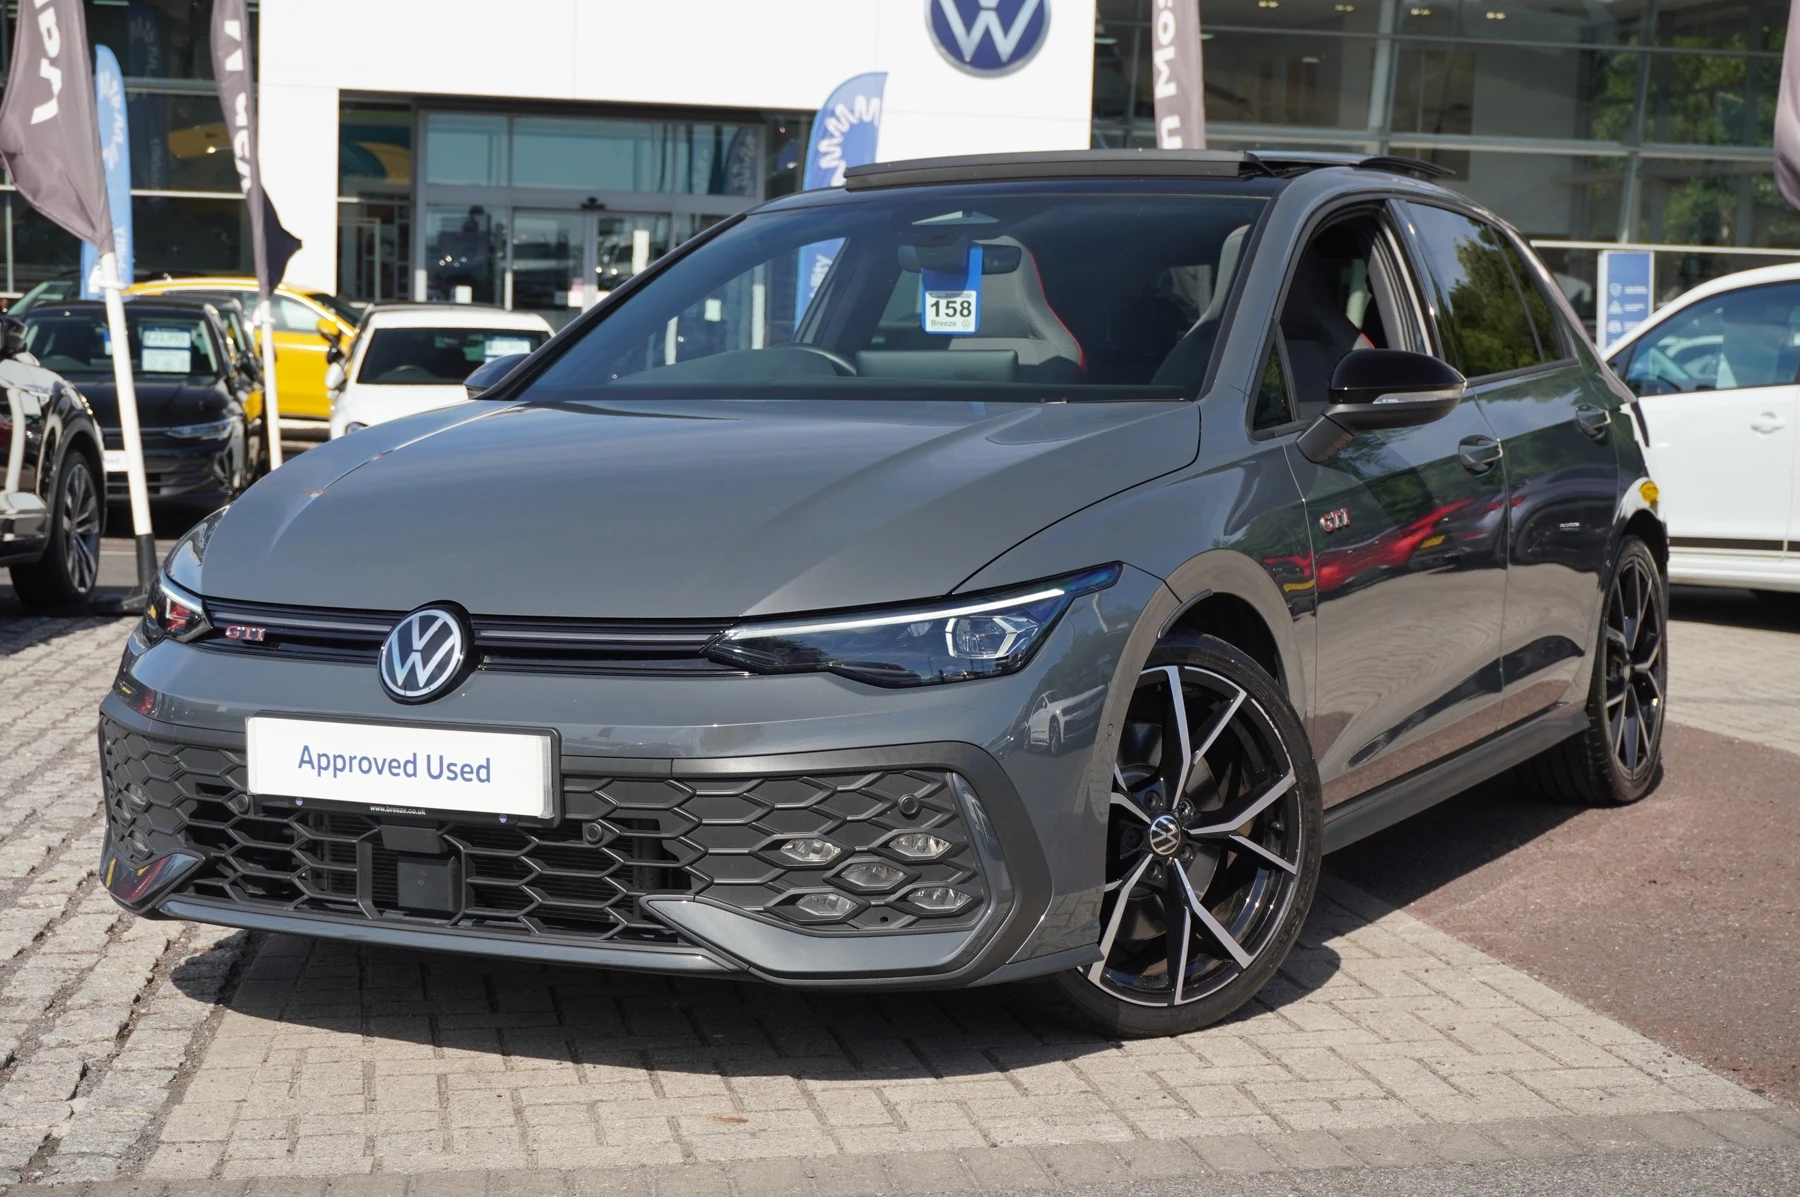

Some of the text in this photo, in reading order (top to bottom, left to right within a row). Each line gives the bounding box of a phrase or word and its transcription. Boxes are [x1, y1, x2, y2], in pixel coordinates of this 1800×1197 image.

[930, 300, 972, 318] 158
[930, 319, 957, 328] Breeze
[1319, 507, 1351, 533] GTI
[225, 624, 266, 642] GTI
[297, 744, 492, 784] Approved Used
[369, 804, 427, 816] www.breeze.co.uk
